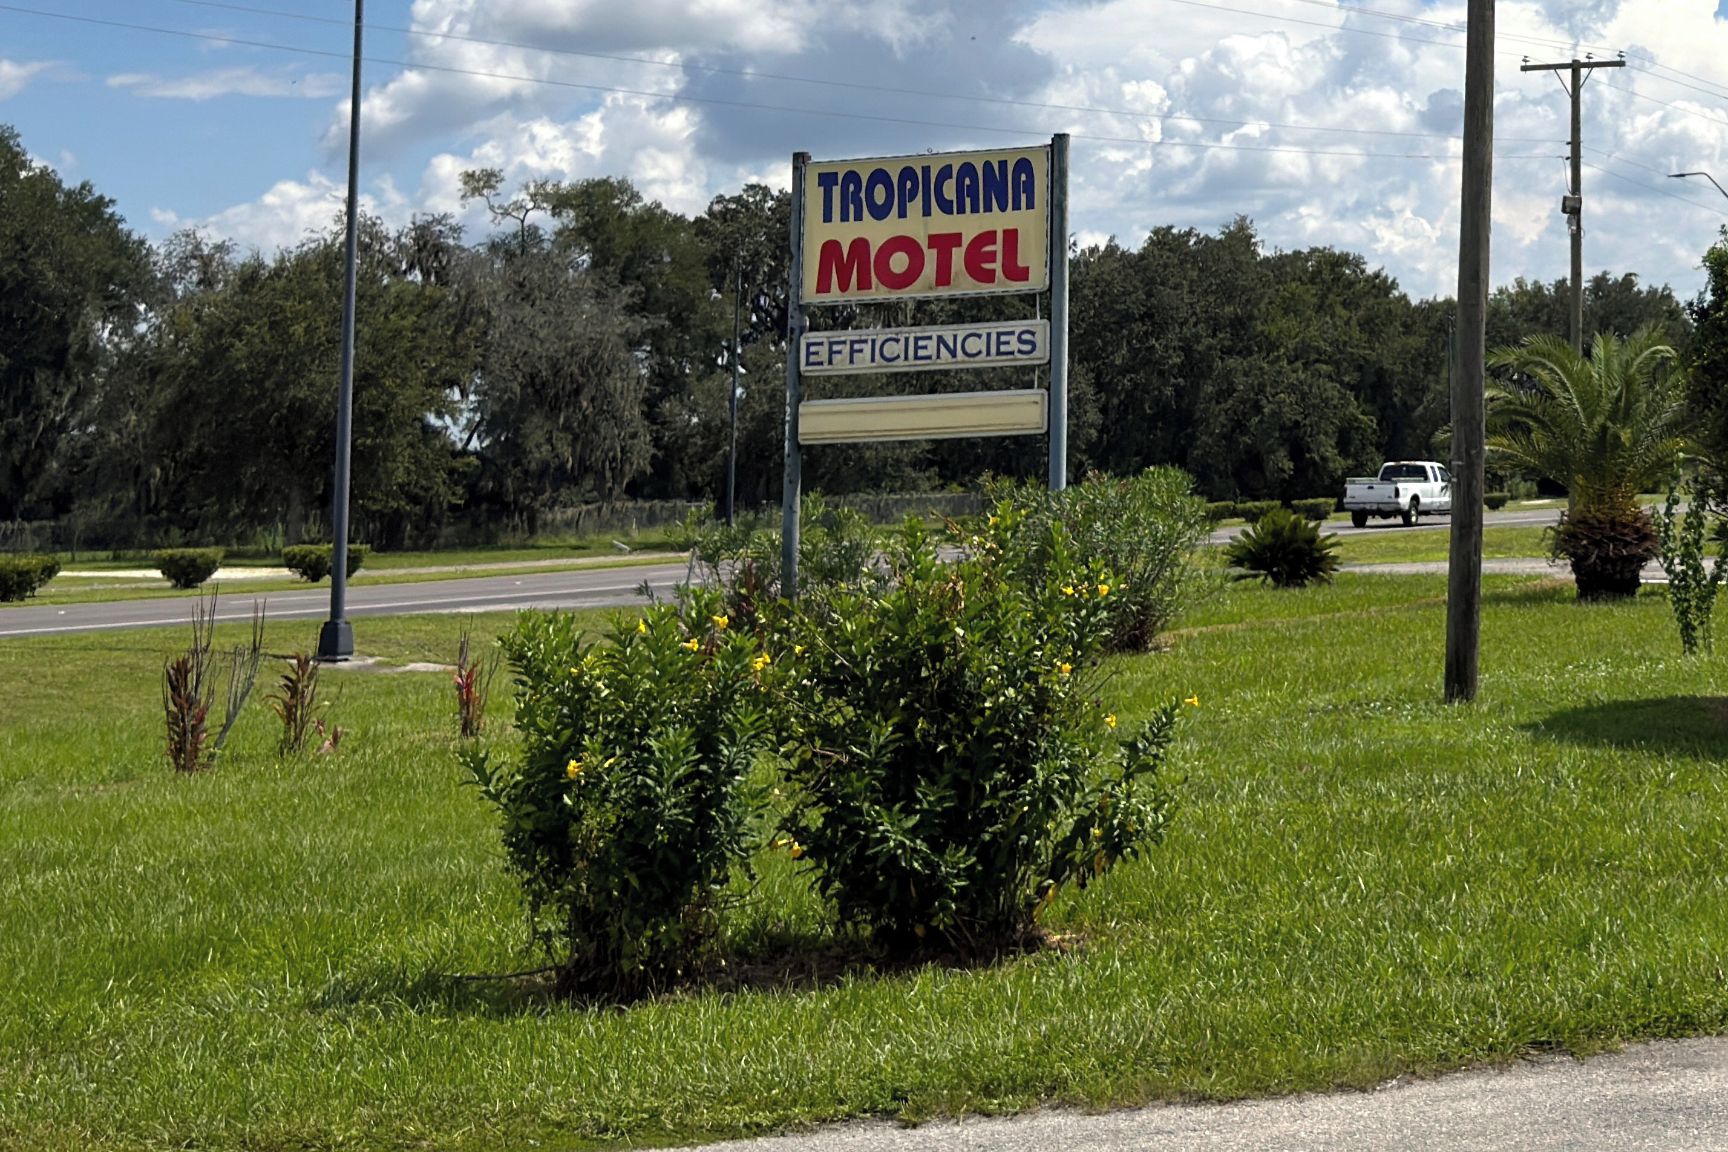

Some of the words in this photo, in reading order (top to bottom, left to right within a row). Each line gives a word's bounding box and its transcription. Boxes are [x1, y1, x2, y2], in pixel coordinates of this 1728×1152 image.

[818, 157, 1035, 223] TROPICANA
[816, 228, 1030, 294] MOTEL
[805, 329, 1037, 366] EFFICIENCIES
